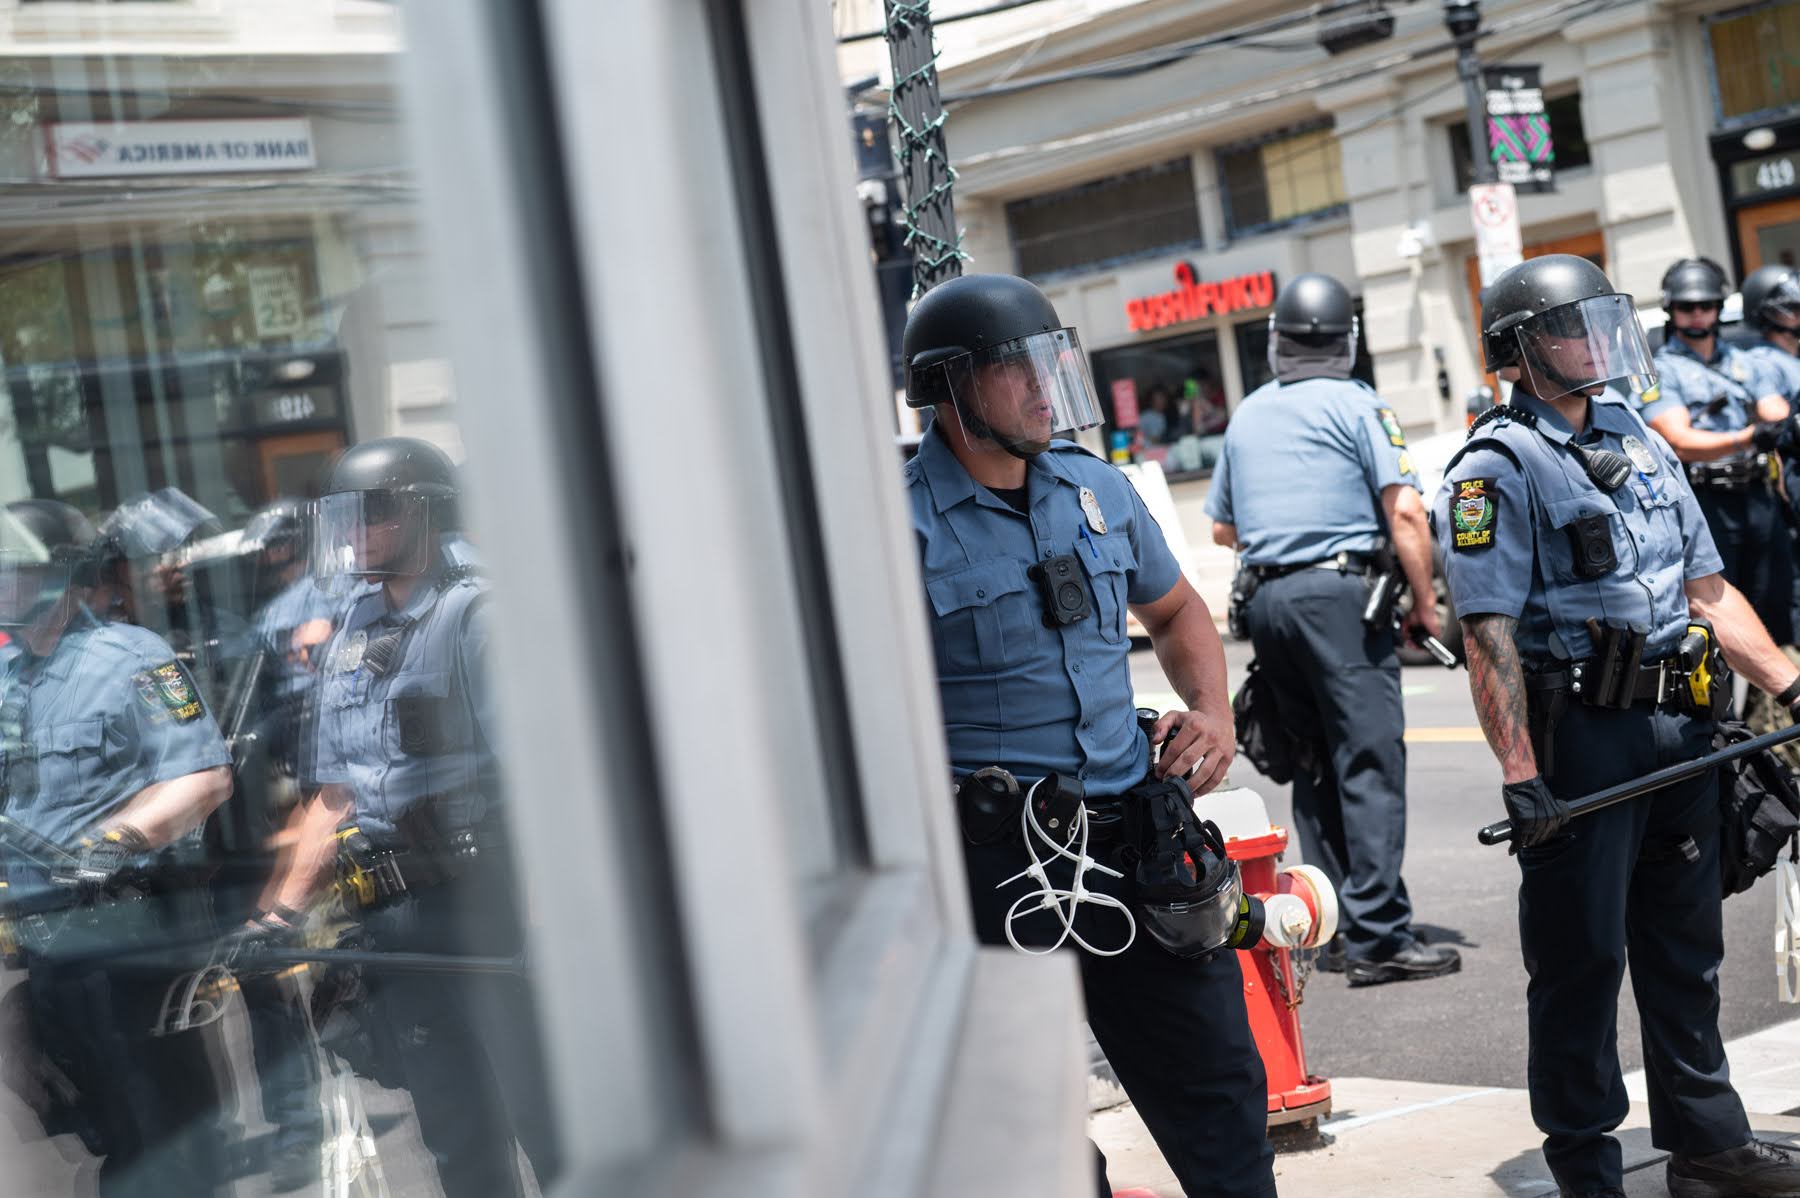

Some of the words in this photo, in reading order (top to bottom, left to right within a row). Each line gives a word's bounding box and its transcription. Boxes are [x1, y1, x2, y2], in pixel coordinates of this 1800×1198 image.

[1756, 158, 1795, 190] 419
[1461, 480, 1484, 490] POLICE
[1456, 531, 1480, 540] COUNTY
[1481, 529, 1491, 538] OF
